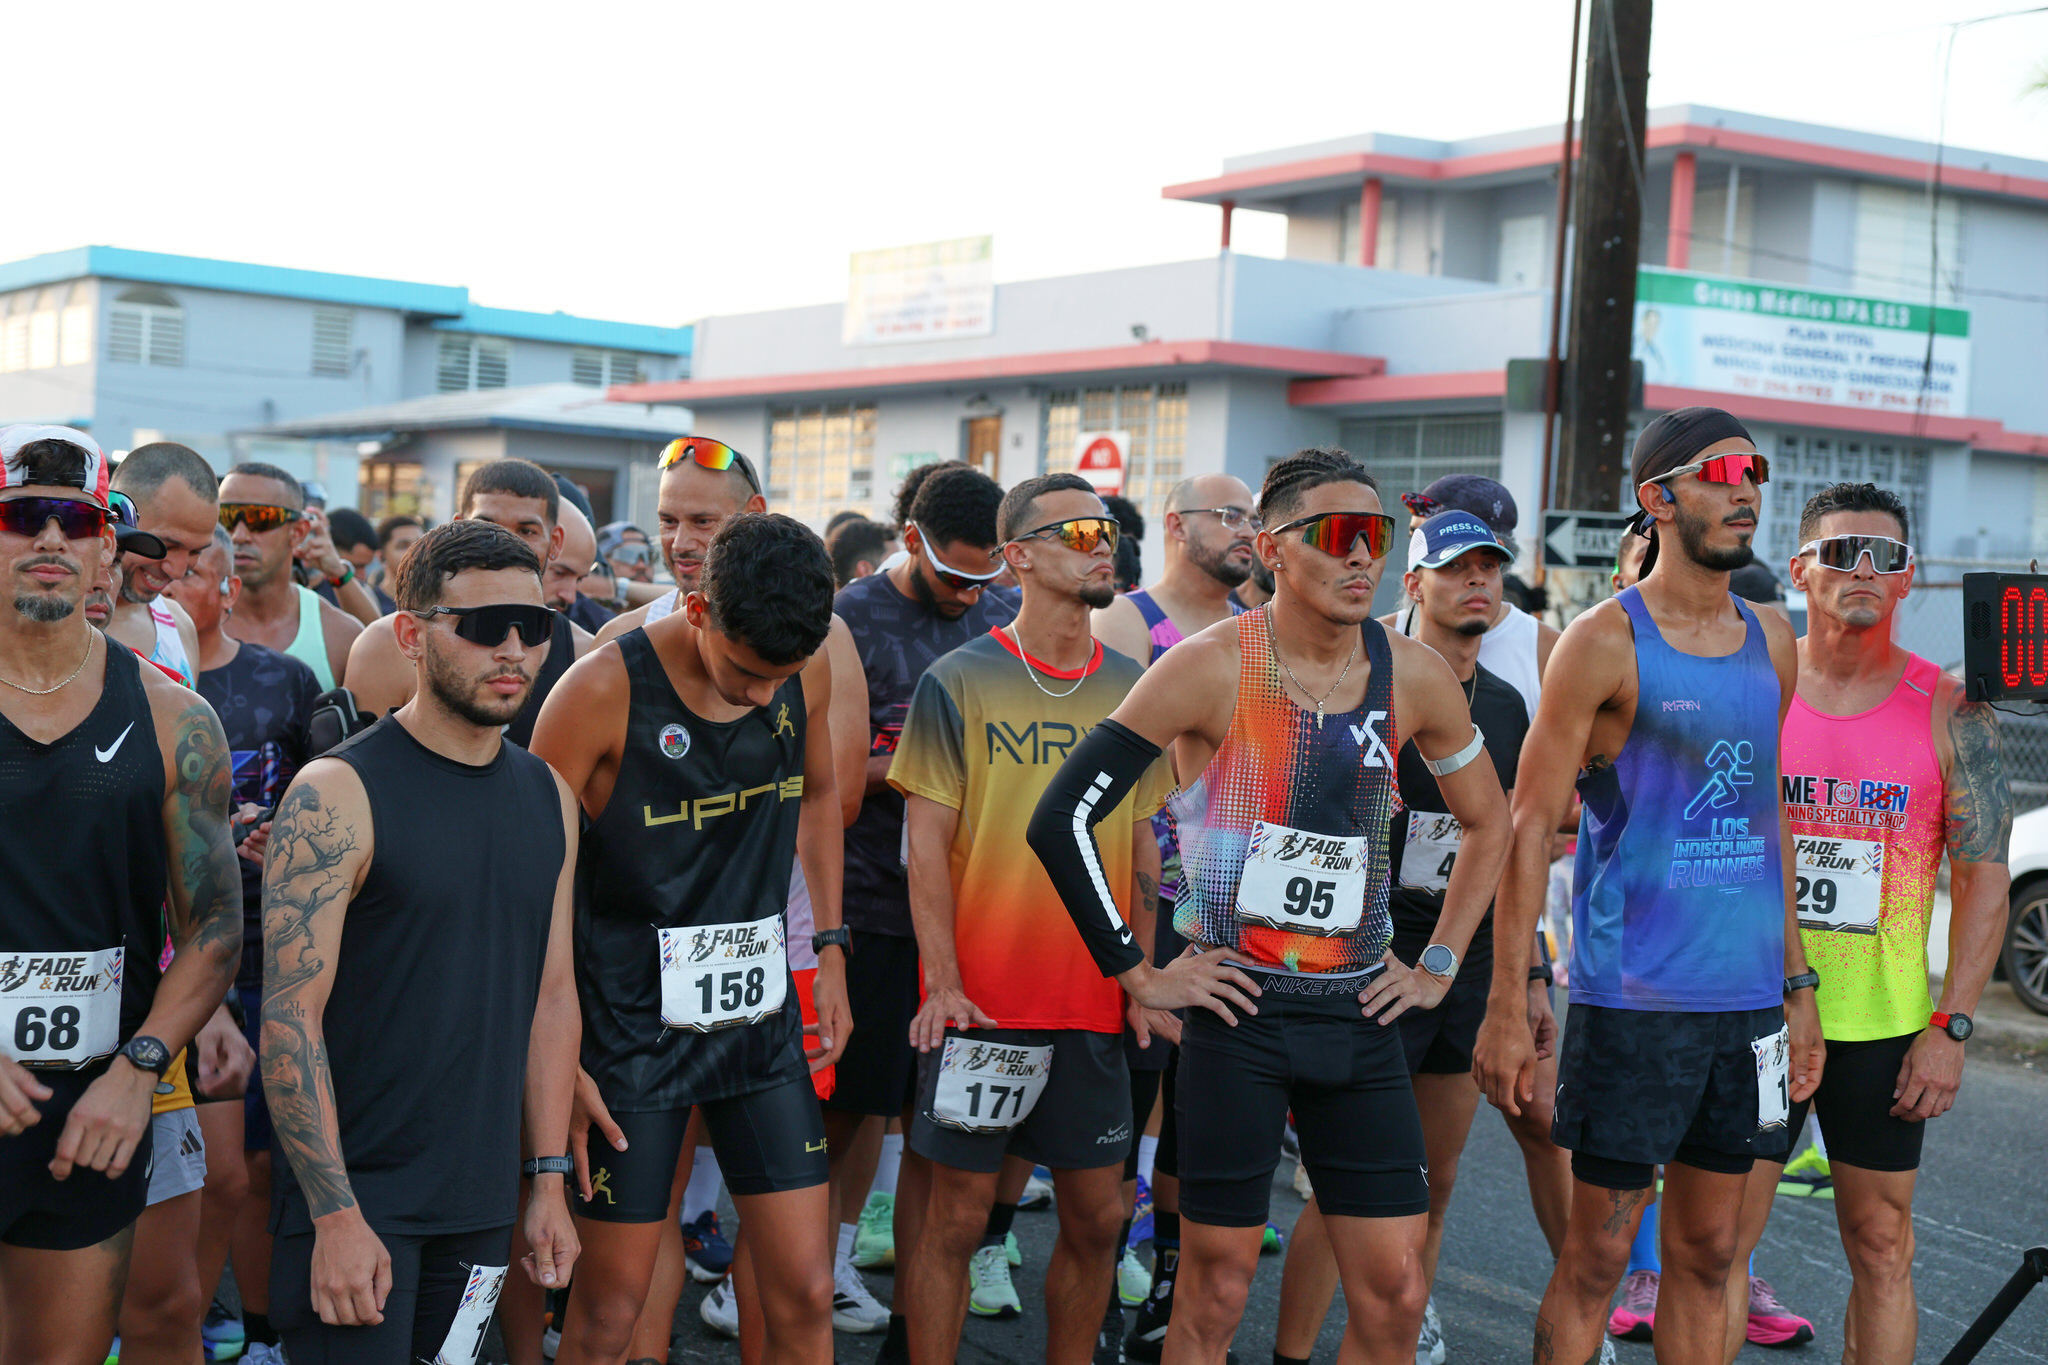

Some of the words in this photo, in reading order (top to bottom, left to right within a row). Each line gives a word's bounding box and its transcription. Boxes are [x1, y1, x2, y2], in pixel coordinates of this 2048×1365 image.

[1439, 522, 1472, 536] PRESS
[1473, 524, 1488, 536] ON
[1859, 779, 1910, 813] RUN
[1785, 805, 1814, 821] NING
[1816, 807, 1876, 826] SPECIALTY
[1878, 812, 1905, 830] SHOP
[1711, 818, 1750, 841] LOS
[1302, 836, 1347, 857] FADE
[1673, 838, 1765, 858] INDISCIPLINADOS
[1796, 839, 1843, 856] FADE
[1309, 854, 1321, 867] &
[1321, 856, 1354, 871] RUN
[1668, 855, 1766, 889] RUNNERS
[1805, 855, 1816, 866] &
[1816, 855, 1856, 870] RUN
[1283, 876, 1337, 919] 95
[1796, 875, 1838, 914] 29
[712, 926, 758, 948] FADE
[723, 945, 735, 958] &
[735, 940, 768, 959] RUN
[27, 957, 87, 977] FADE
[39, 976, 52, 990] &
[53, 975, 99, 992] RUN
[695, 966, 765, 1015] 158
[1262, 975, 1328, 996] NIKE
[1325, 975, 1371, 996] PRO
[14, 1005, 80, 1052] 68
[987, 1047, 1029, 1064] FADE
[995, 1063, 1005, 1074] &
[1006, 1064, 1036, 1077] RUN
[966, 1082, 1026, 1120] 171
